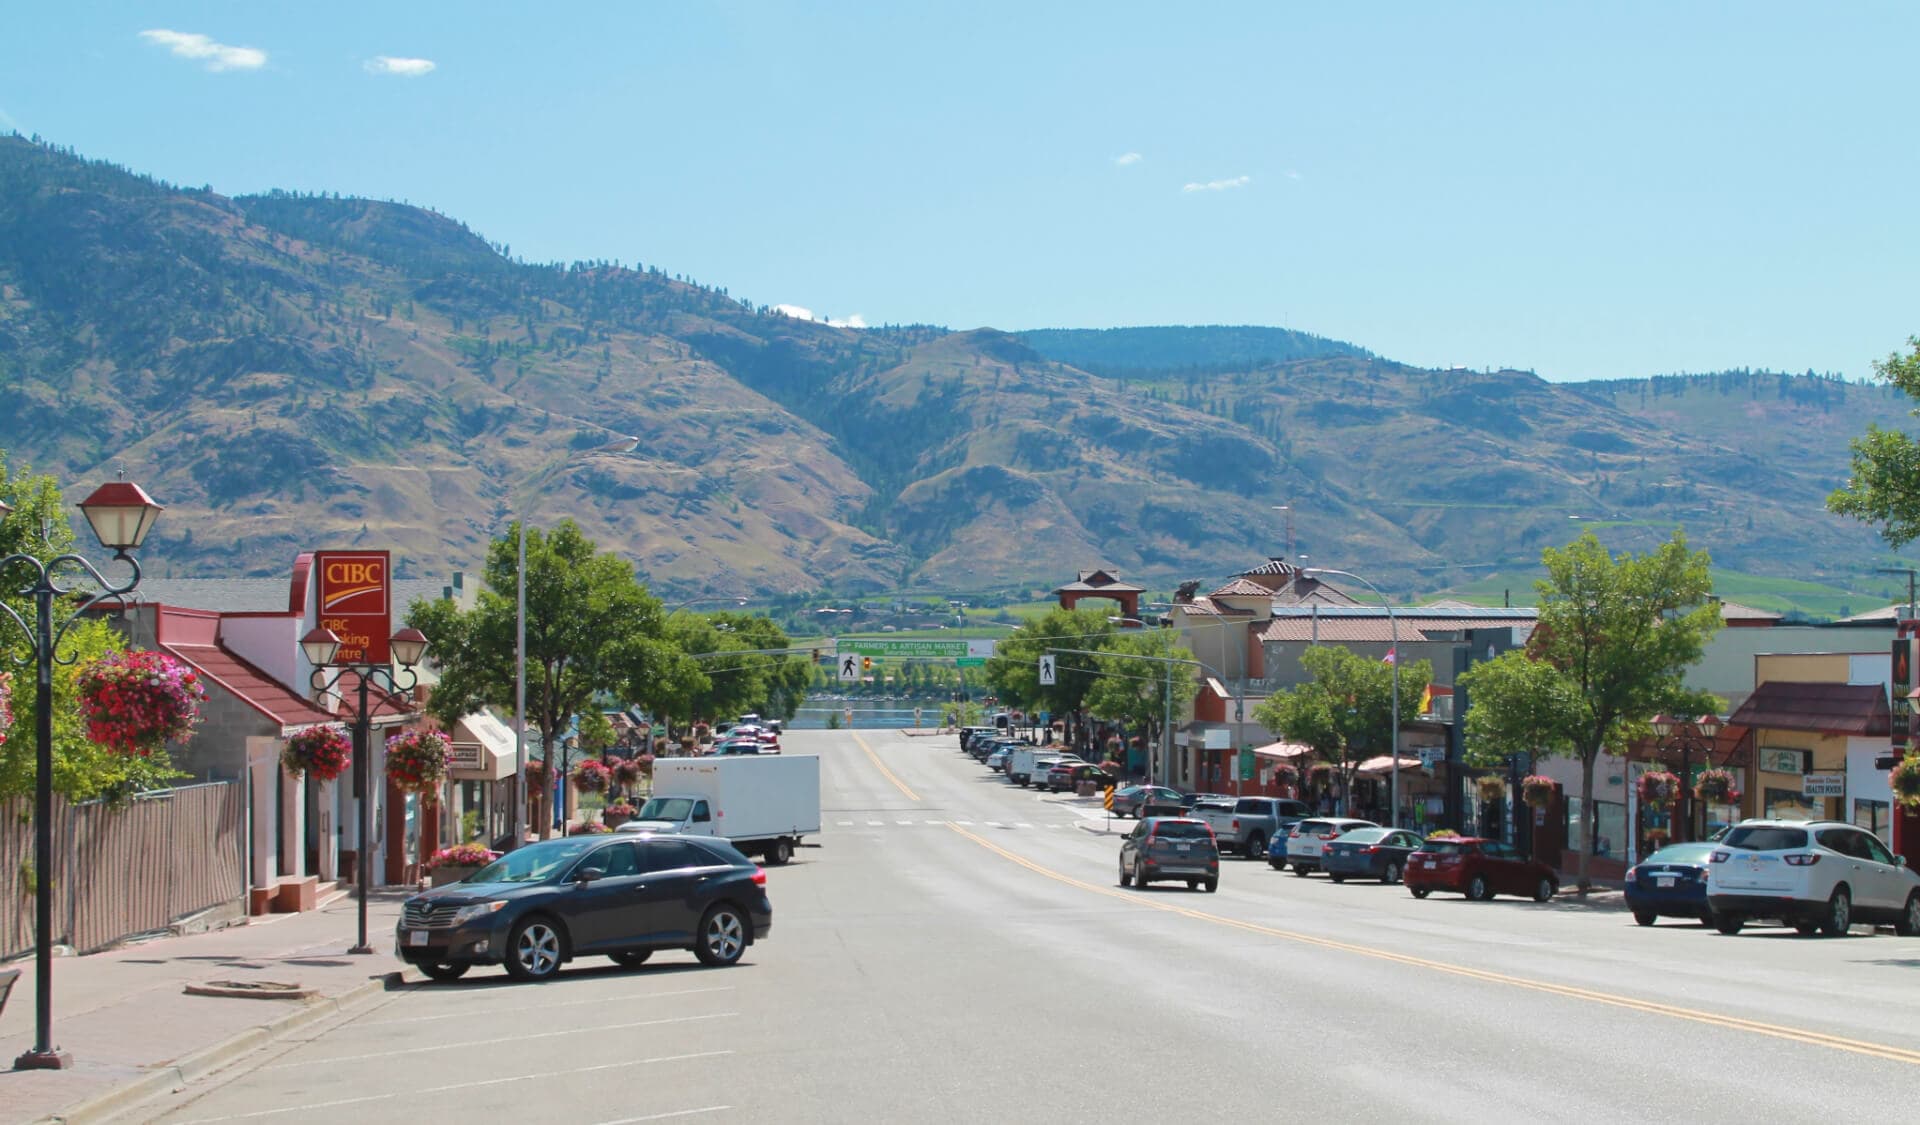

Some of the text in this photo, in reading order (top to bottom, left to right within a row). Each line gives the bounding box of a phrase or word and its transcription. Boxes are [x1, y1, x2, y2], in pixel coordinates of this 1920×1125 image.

[327, 563, 381, 584] CIBC
[321, 619, 349, 631] CIBC
[339, 633, 369, 648] king
[854, 642, 889, 650] FARMERS
[891, 642, 897, 650] &
[900, 642, 932, 650] ARTISAN
[935, 642, 968, 650] MARKET
[336, 648, 361, 660] ntre
[1805, 784, 1842, 794] HEALTH FOODS
